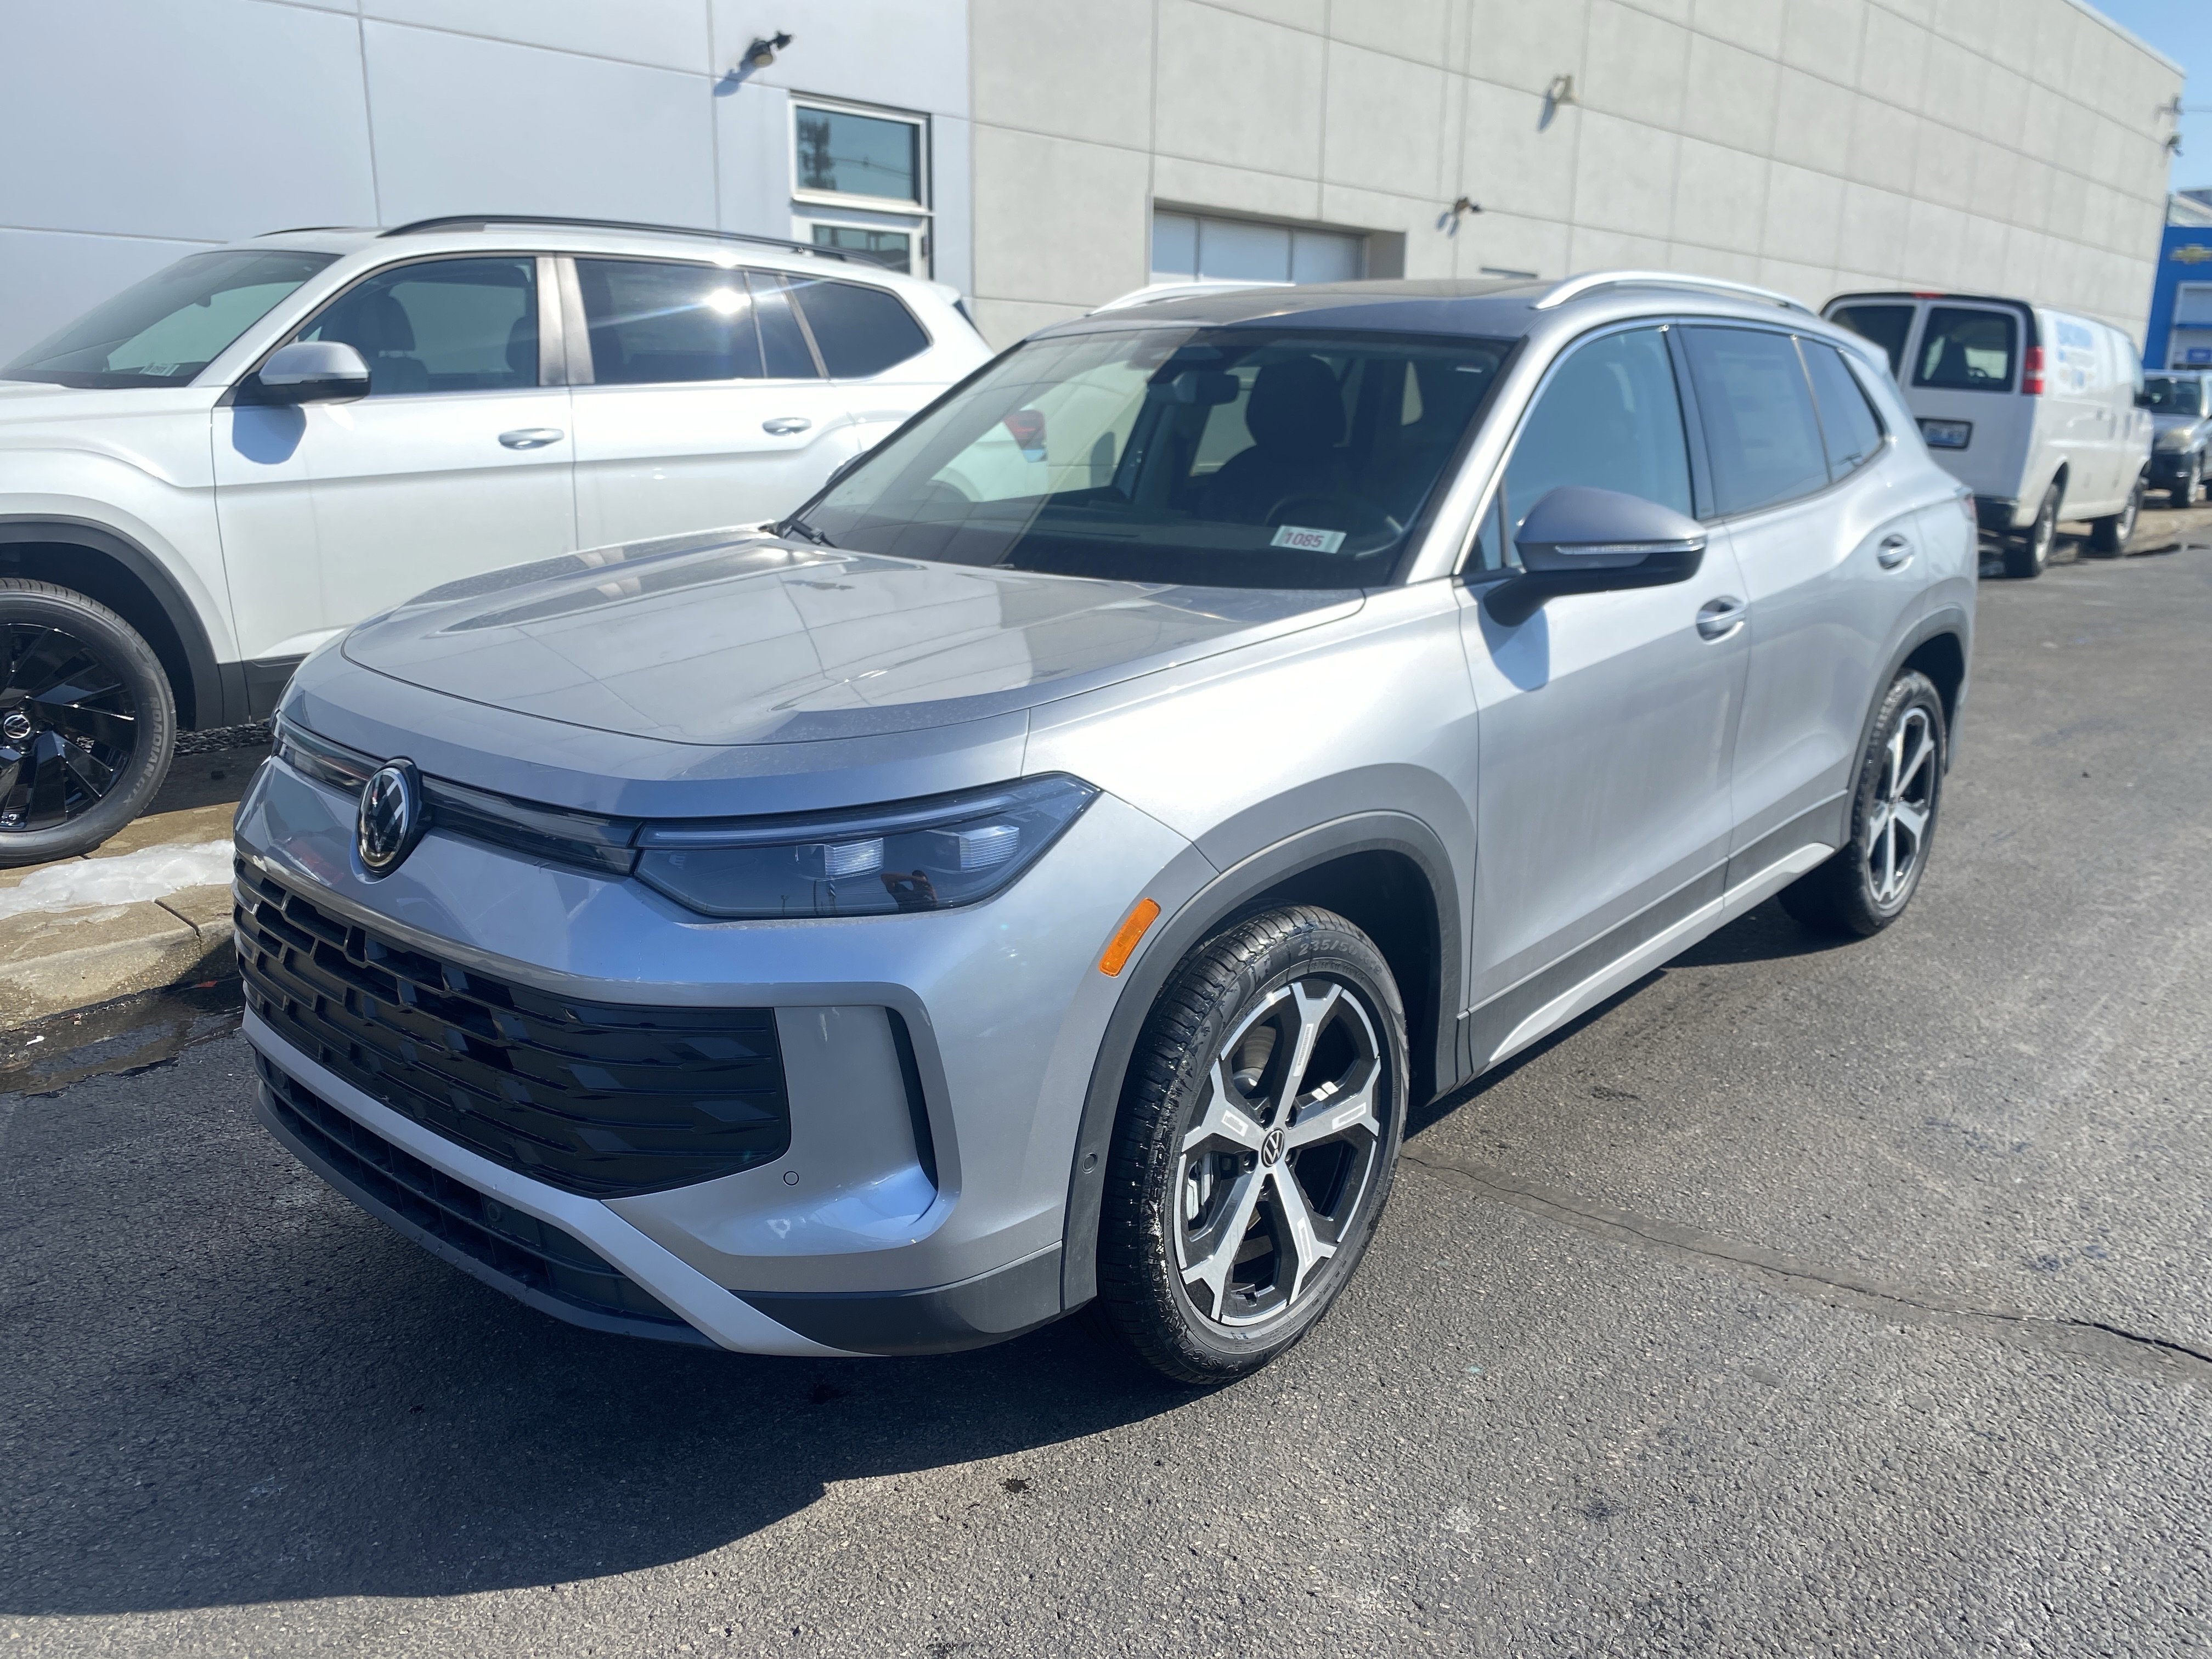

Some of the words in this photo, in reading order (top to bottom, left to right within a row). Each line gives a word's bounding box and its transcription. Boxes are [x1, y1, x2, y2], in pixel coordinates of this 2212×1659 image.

[1284, 532, 1325, 548] 1085
[1297, 938, 1358, 956] 235/50
[1261, 1129, 1285, 1167] VW
